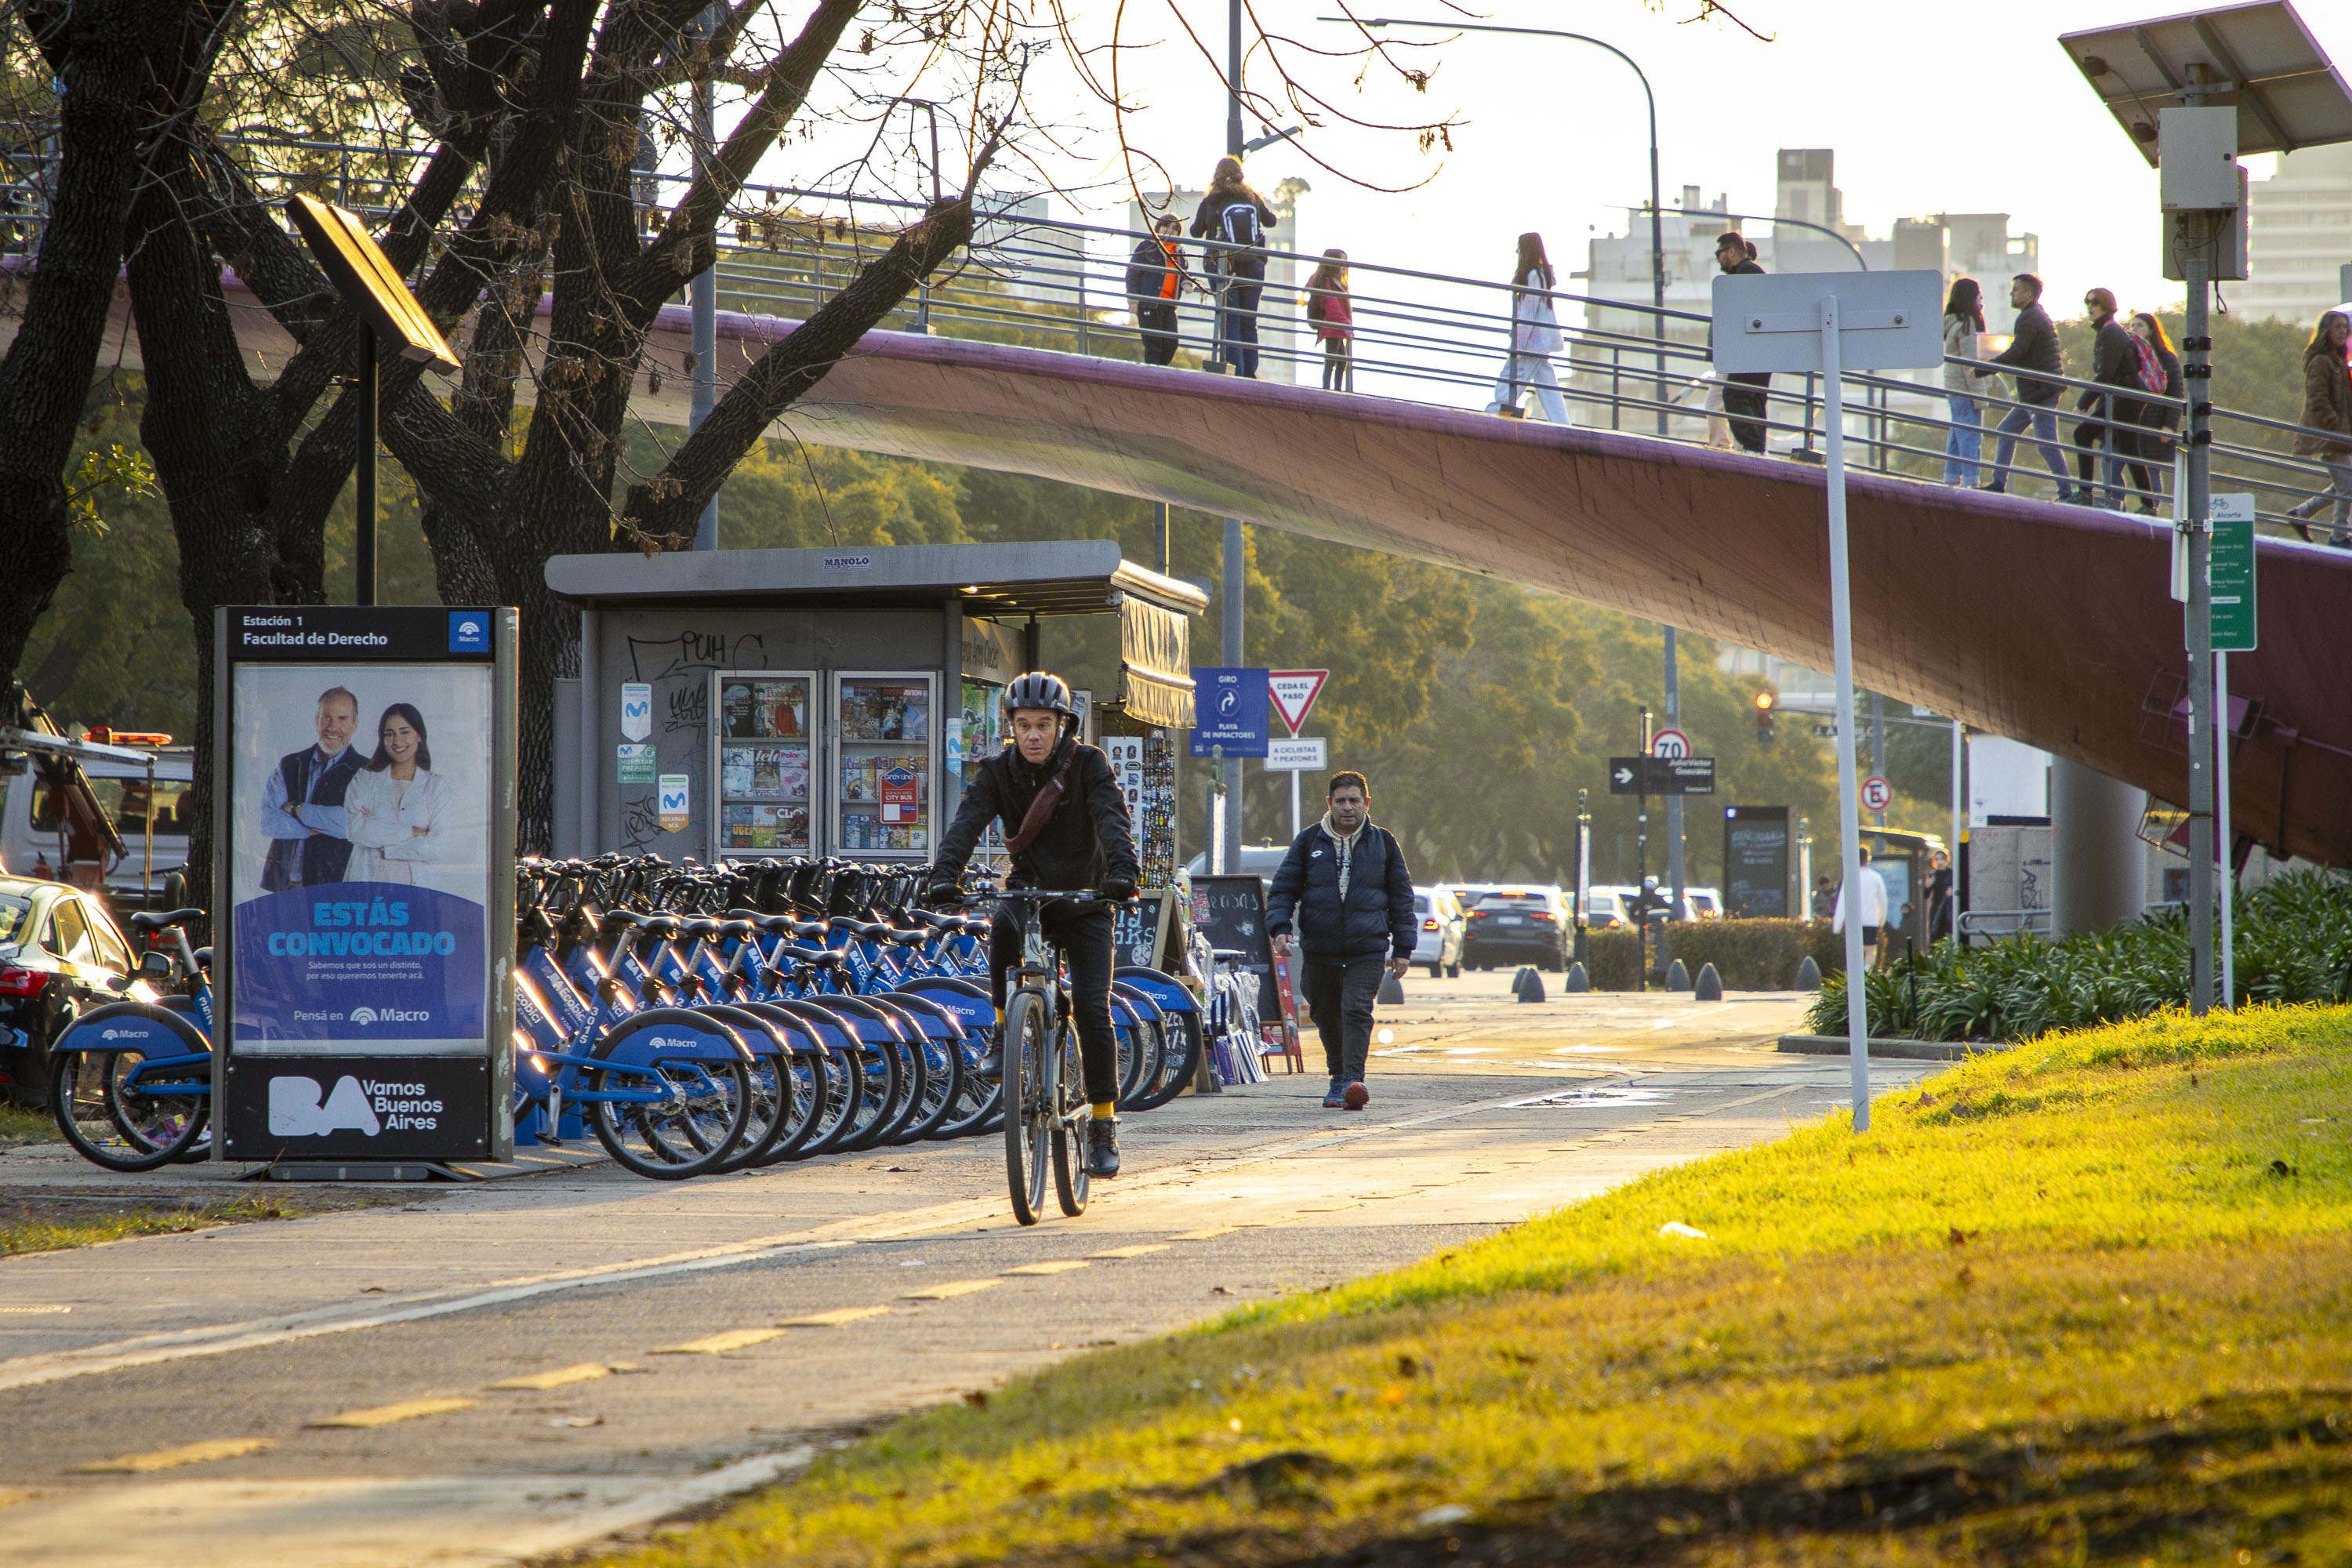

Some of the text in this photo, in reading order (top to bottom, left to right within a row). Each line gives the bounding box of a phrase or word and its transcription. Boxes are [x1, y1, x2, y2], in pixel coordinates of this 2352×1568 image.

[824, 557, 869, 566] MANOLO
[243, 615, 303, 626] Estación 1
[243, 633, 388, 645] Facultad de Derecho
[1218, 675, 1237, 684] GIRO
[1658, 742, 1682, 759] 70
[1869, 784, 1882, 803] E
[314, 896, 409, 927] ESTÁS
[267, 931, 456, 956] CONVOCADO
[346, 963, 361, 971] que
[390, 961, 423, 971] distinto,
[408, 971, 424, 980] acá.
[514, 985, 543, 1023] Ecobici
[947, 1004, 975, 1016] Macro
[294, 1008, 430, 1022] Pensá en Macro
[119, 1029, 149, 1038] Macro
[667, 1038, 697, 1048] Macro
[361, 1080, 426, 1096] Vamos
[269, 1075, 380, 1137] BA
[374, 1097, 444, 1113] Buenos
[385, 1114, 437, 1130] Aires
